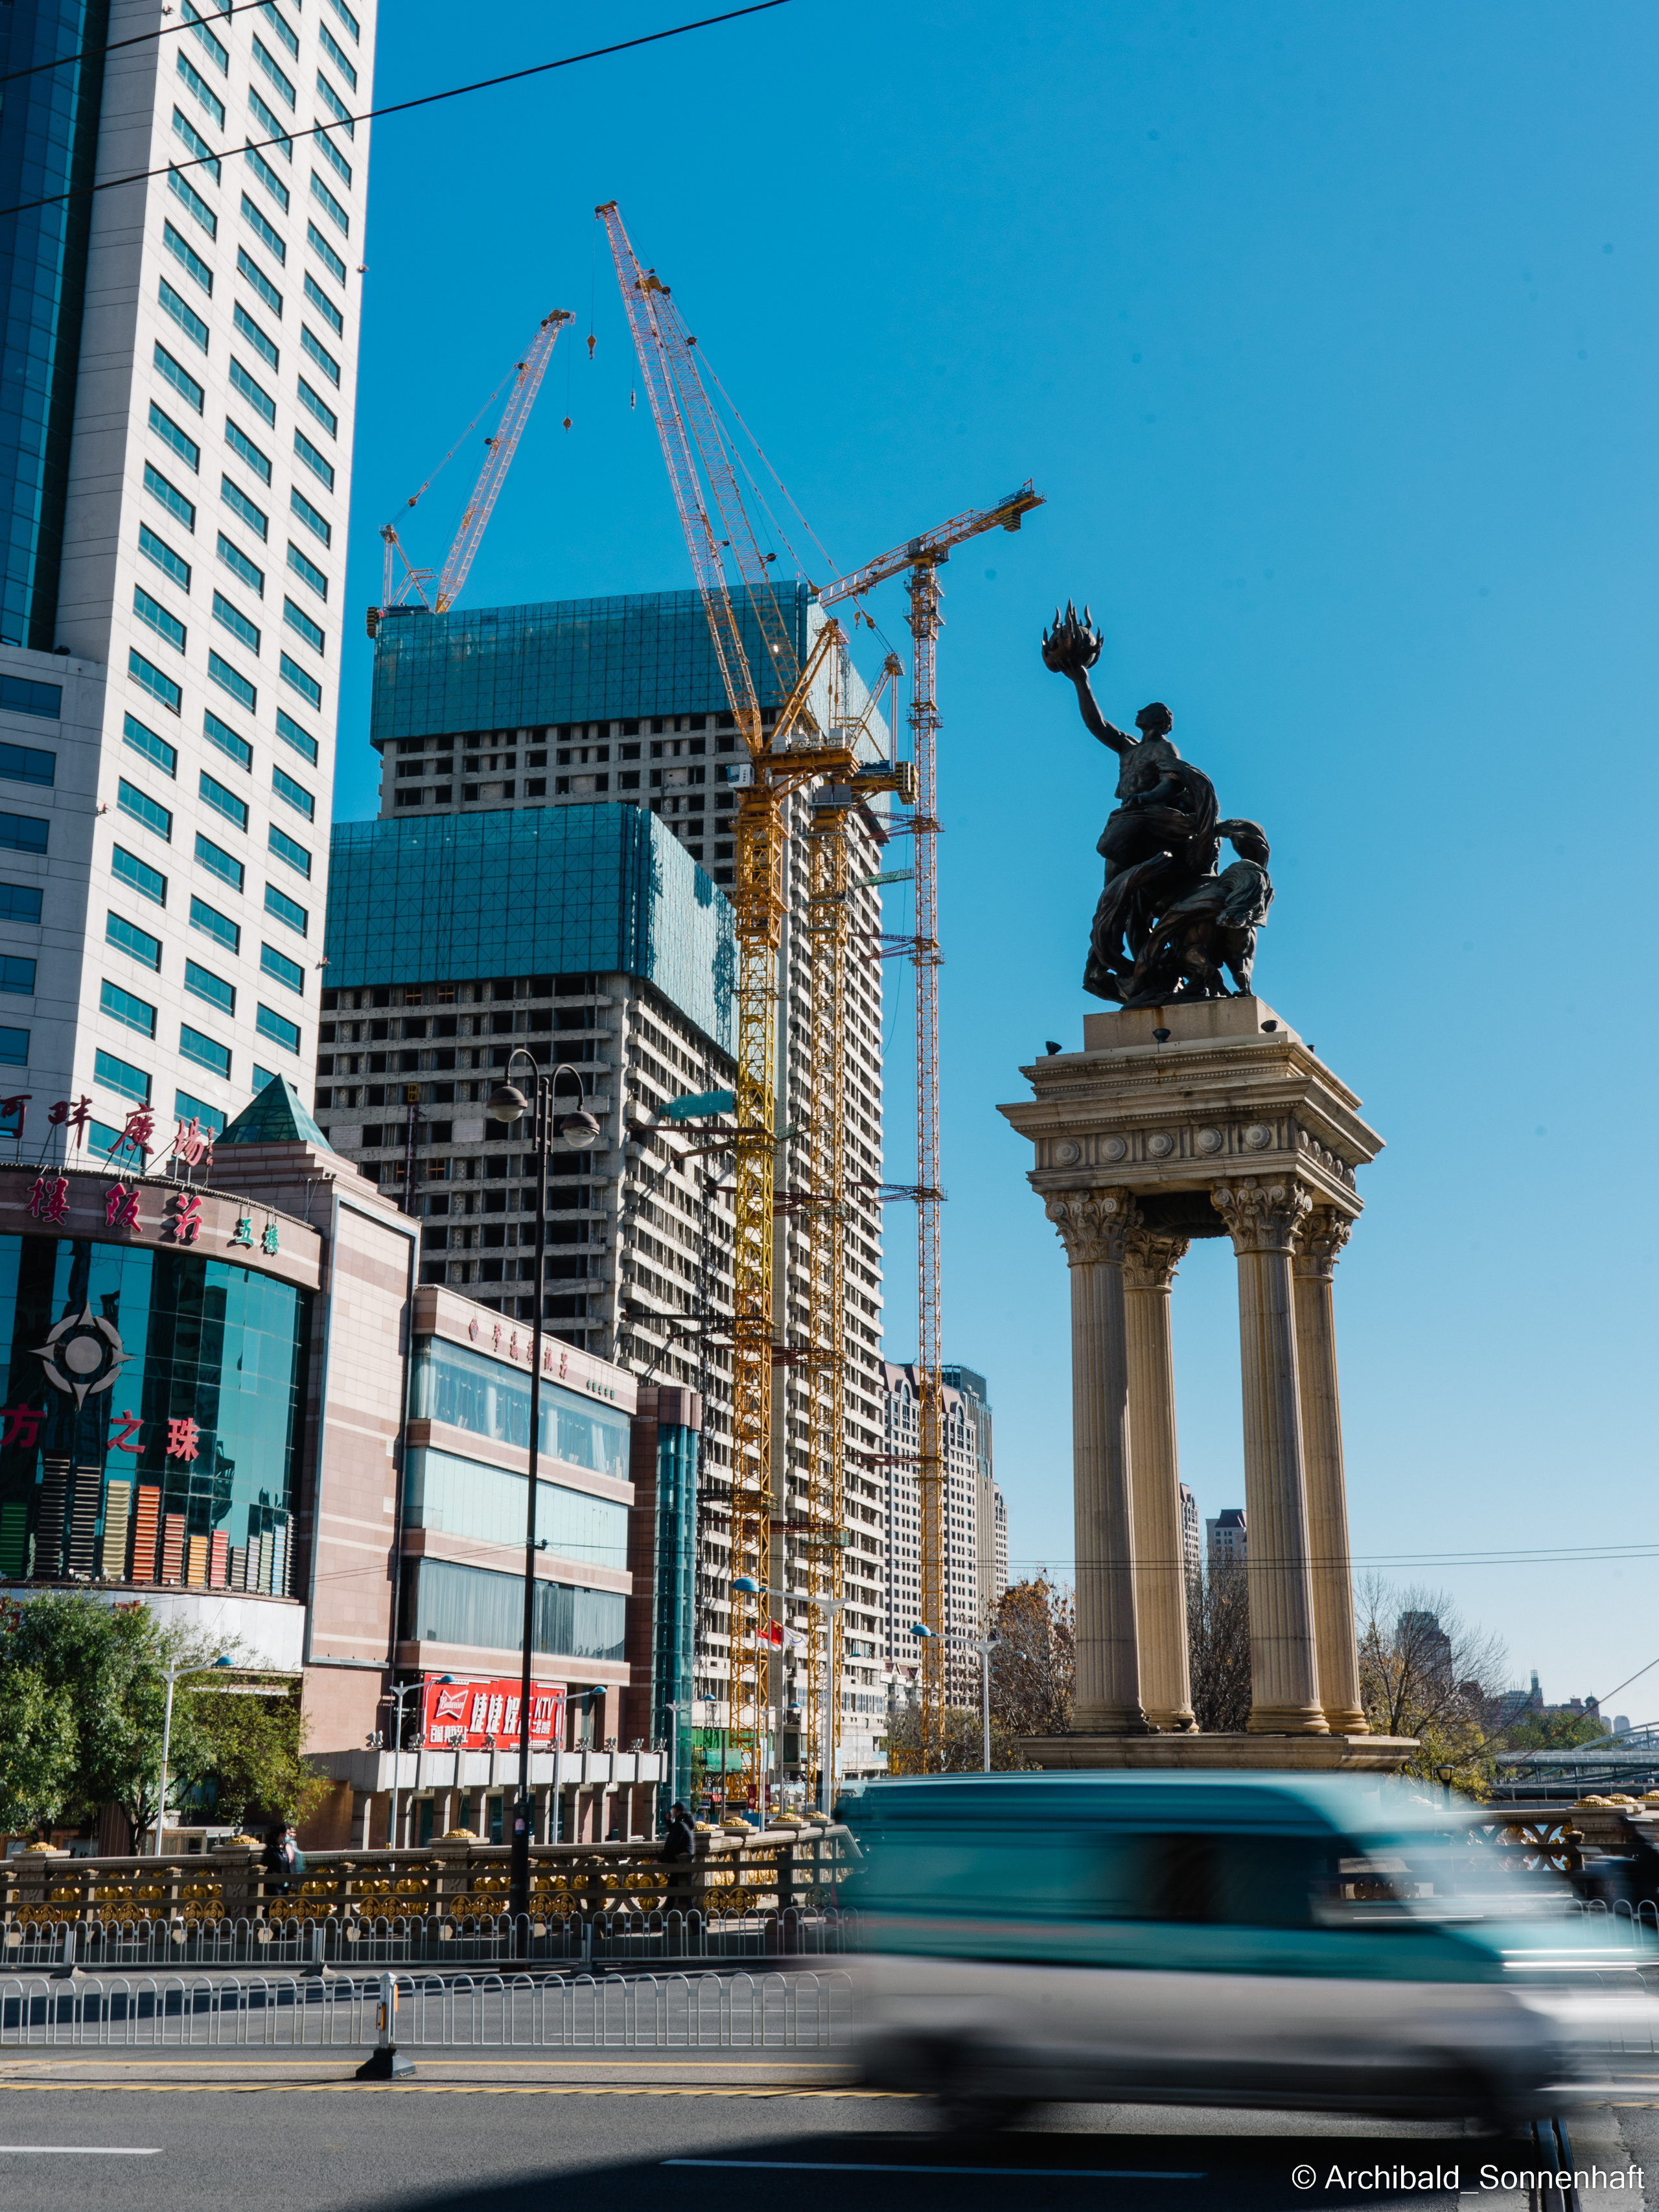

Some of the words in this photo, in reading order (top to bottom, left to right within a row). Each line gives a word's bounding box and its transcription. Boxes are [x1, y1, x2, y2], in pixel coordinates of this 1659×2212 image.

[439, 1696, 464, 1709] Budweiser
[469, 1692, 533, 1734] 婕婕娱
[535, 1697, 554, 1719] KTV
